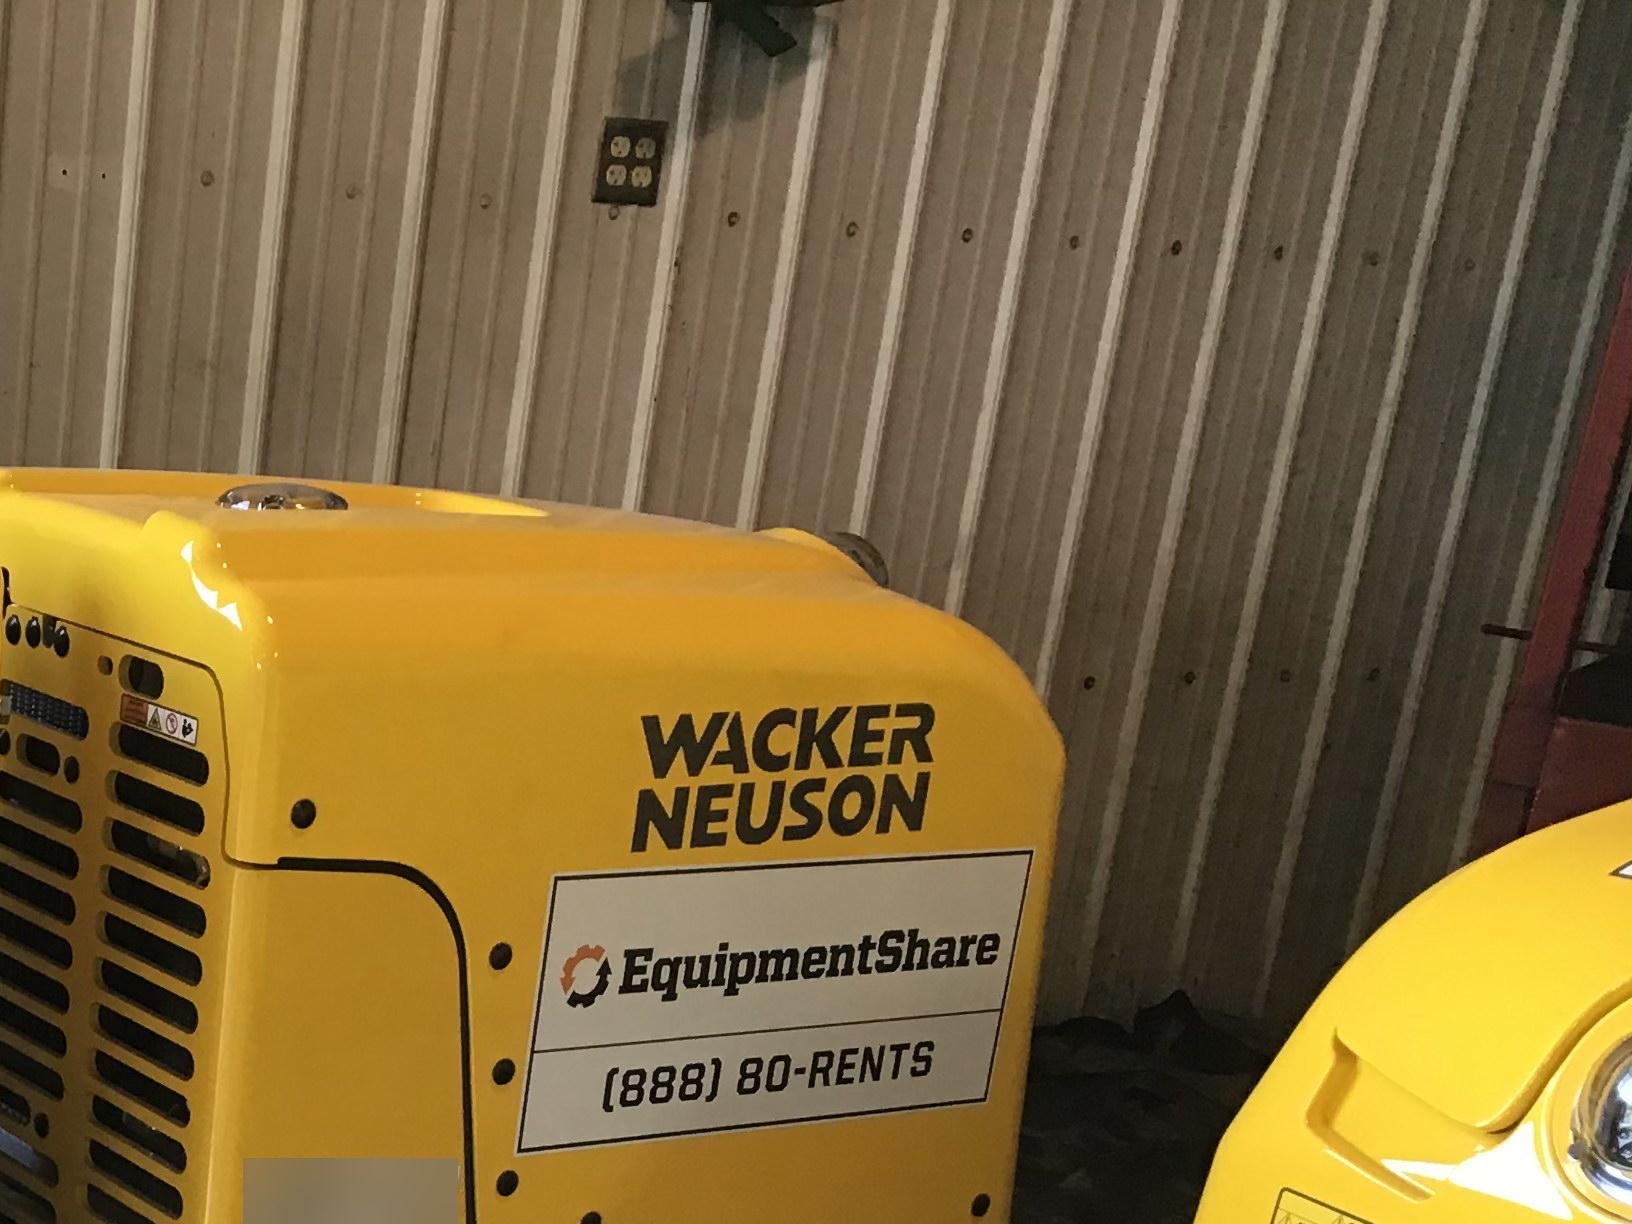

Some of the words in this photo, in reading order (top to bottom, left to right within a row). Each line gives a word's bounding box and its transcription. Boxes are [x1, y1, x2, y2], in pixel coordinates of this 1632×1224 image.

[640, 702, 936, 779] WACKER
[630, 771, 931, 853] NEUSON
[618, 928, 1001, 1001] EquipmentShare
[601, 1057, 721, 1113] (888)
[736, 1040, 935, 1095] 80-RENTS
